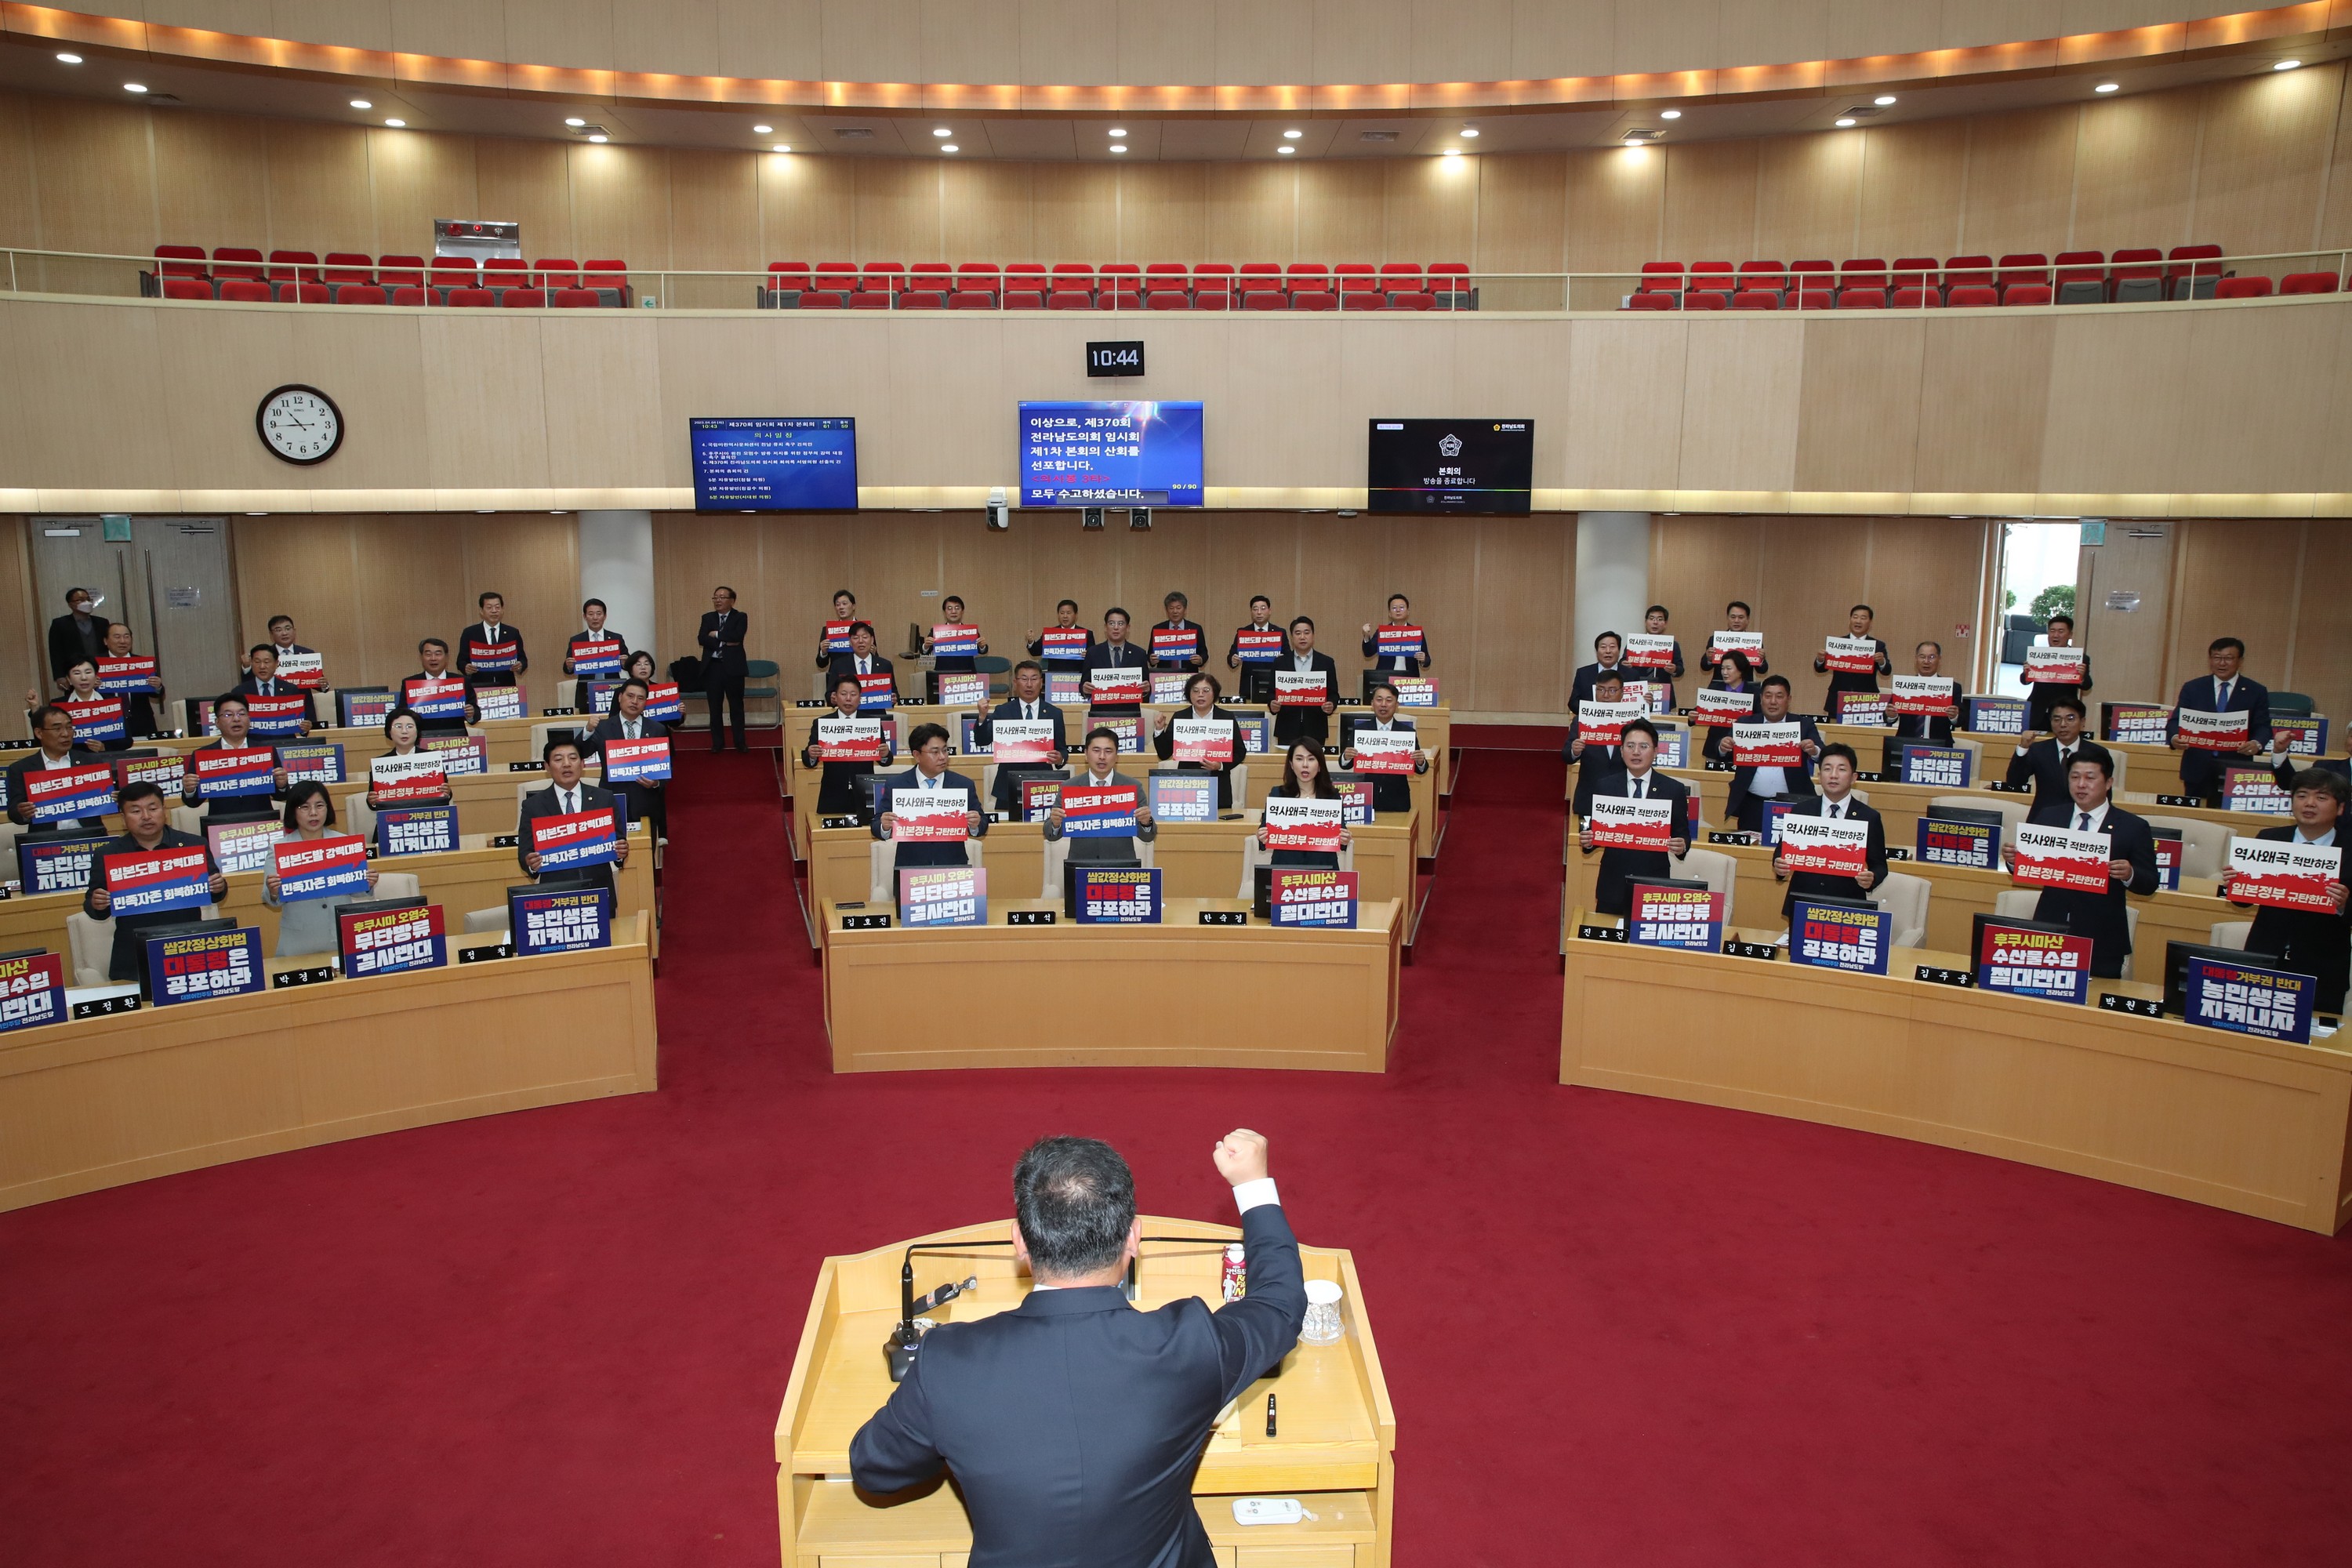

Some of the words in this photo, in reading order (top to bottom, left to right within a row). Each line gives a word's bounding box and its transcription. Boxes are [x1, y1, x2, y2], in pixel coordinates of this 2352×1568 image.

[1093, 350, 1138, 366] 10:44
[1030, 418, 1081, 428] 이상으로,
[1084, 418, 1131, 428] 제370회
[1030, 432, 1101, 443] 전라남도의회
[1105, 432, 1140, 443] 임시회
[1030, 447, 1062, 456] 제1차
[1065, 447, 1100, 456] 본회의
[1105, 447, 1139, 456] 산회를
[1031, 461, 1094, 471] 선포합니다.
[1031, 489, 1054, 499] 모두
[1058, 489, 1145, 499] 수고하셨습니다.
[1736, 730, 1769, 739] 역사왜곡
[608, 746, 640, 758] 일본도발
[641, 742, 668, 754] 강력대응
[1736, 753, 1769, 762] 일본정부
[199, 756, 238, 771] 일본도발
[239, 752, 271, 765] 강력대응
[610, 765, 640, 778] 민족자존
[201, 779, 238, 793] 민족자존
[239, 773, 273, 787] 회복하자!
[896, 797, 935, 808] 역사왜곡
[936, 799, 966, 808] 적반하장
[1065, 797, 1101, 809] 일본도발
[1103, 793, 1135, 804] 강력대응
[1269, 805, 1308, 817] 역사왜곡
[1309, 809, 1340, 818] 적반하장
[1595, 803, 1636, 816] 역사왜곡
[1638, 808, 1669, 817] 적반하장
[536, 823, 577, 842] 일본도발
[578, 815, 612, 833] 강력대응
[896, 826, 934, 837] 일본정부
[935, 827, 966, 837] 규탄한다!
[1065, 819, 1101, 833] 민족자존
[1102, 817, 1136, 829] 회복하자!
[1787, 823, 1829, 837] 역사왜곡
[1831, 829, 1865, 840] 적반하장
[1269, 834, 1306, 846] 일본정부
[1308, 837, 1339, 847] 규탄한다!
[1595, 831, 1634, 844] 일본정부
[2020, 832, 2067, 849] 역사왜곡
[2070, 840, 2107, 855] 적반하장
[278, 848, 325, 869] 일본도발
[325, 842, 364, 859] 강력대응
[1784, 853, 1826, 867] 일본정부
[1828, 861, 1863, 872] 규탄한다!
[2234, 848, 2290, 866] 역사왜곡
[2292, 855, 2338, 870] 적반하장
[110, 861, 161, 881] 일본도발
[162, 853, 205, 872] 강력대응
[281, 877, 325, 896] 민족자존
[327, 869, 367, 887] 회복하자!
[910, 872, 946, 886] 후쿠시마
[947, 869, 974, 881] 오염수
[1087, 872, 1150, 884] 쌀값정상화법
[1281, 873, 1337, 887] 후쿠시마산
[2016, 865, 2065, 881] 일본정부
[2066, 873, 2105, 887] 규탄한다!
[113, 889, 162, 910] 민족자존
[164, 883, 209, 901] 회복하자!
[581, 894, 599, 905] 반대
[910, 880, 974, 902] 무단방류
[1087, 884, 1151, 900] 대통령은
[1280, 885, 1348, 902] 수산물수입
[1642, 893, 1681, 903] 후쿠시마
[1682, 894, 1711, 902] 오염수
[2230, 882, 2285, 900] 일본정부
[910, 899, 975, 922] 결사반대
[1087, 901, 1151, 916] 공포하라
[1280, 901, 1348, 922] 절대반대
[1641, 904, 1711, 920] 무단방류
[354, 914, 396, 933] 후쿠시마
[398, 908, 430, 924] 오염수
[527, 906, 598, 929] 농민생존
[1807, 907, 1878, 928] 쌀값정상화법
[354, 920, 431, 950] 무단방류
[528, 924, 600, 946] 지켜내자
[1639, 924, 1709, 940] 결사반대
[1805, 922, 1877, 942] 대통령은
[163, 933, 247, 956] 쌀값정상화법
[1994, 933, 2064, 949] 후쿠시마산
[356, 939, 432, 972] 결사반대
[1803, 939, 1877, 964] 공포하라
[1992, 949, 2078, 967] 수산물수입
[163, 947, 249, 975] 대통령은
[166, 966, 251, 995] 공포하라
[1990, 967, 2076, 989] 절대반대
[2276, 978, 2301, 991] 반대
[2201, 979, 2296, 1011] 농민생존
[2200, 999, 2295, 1031] 지켜내자
